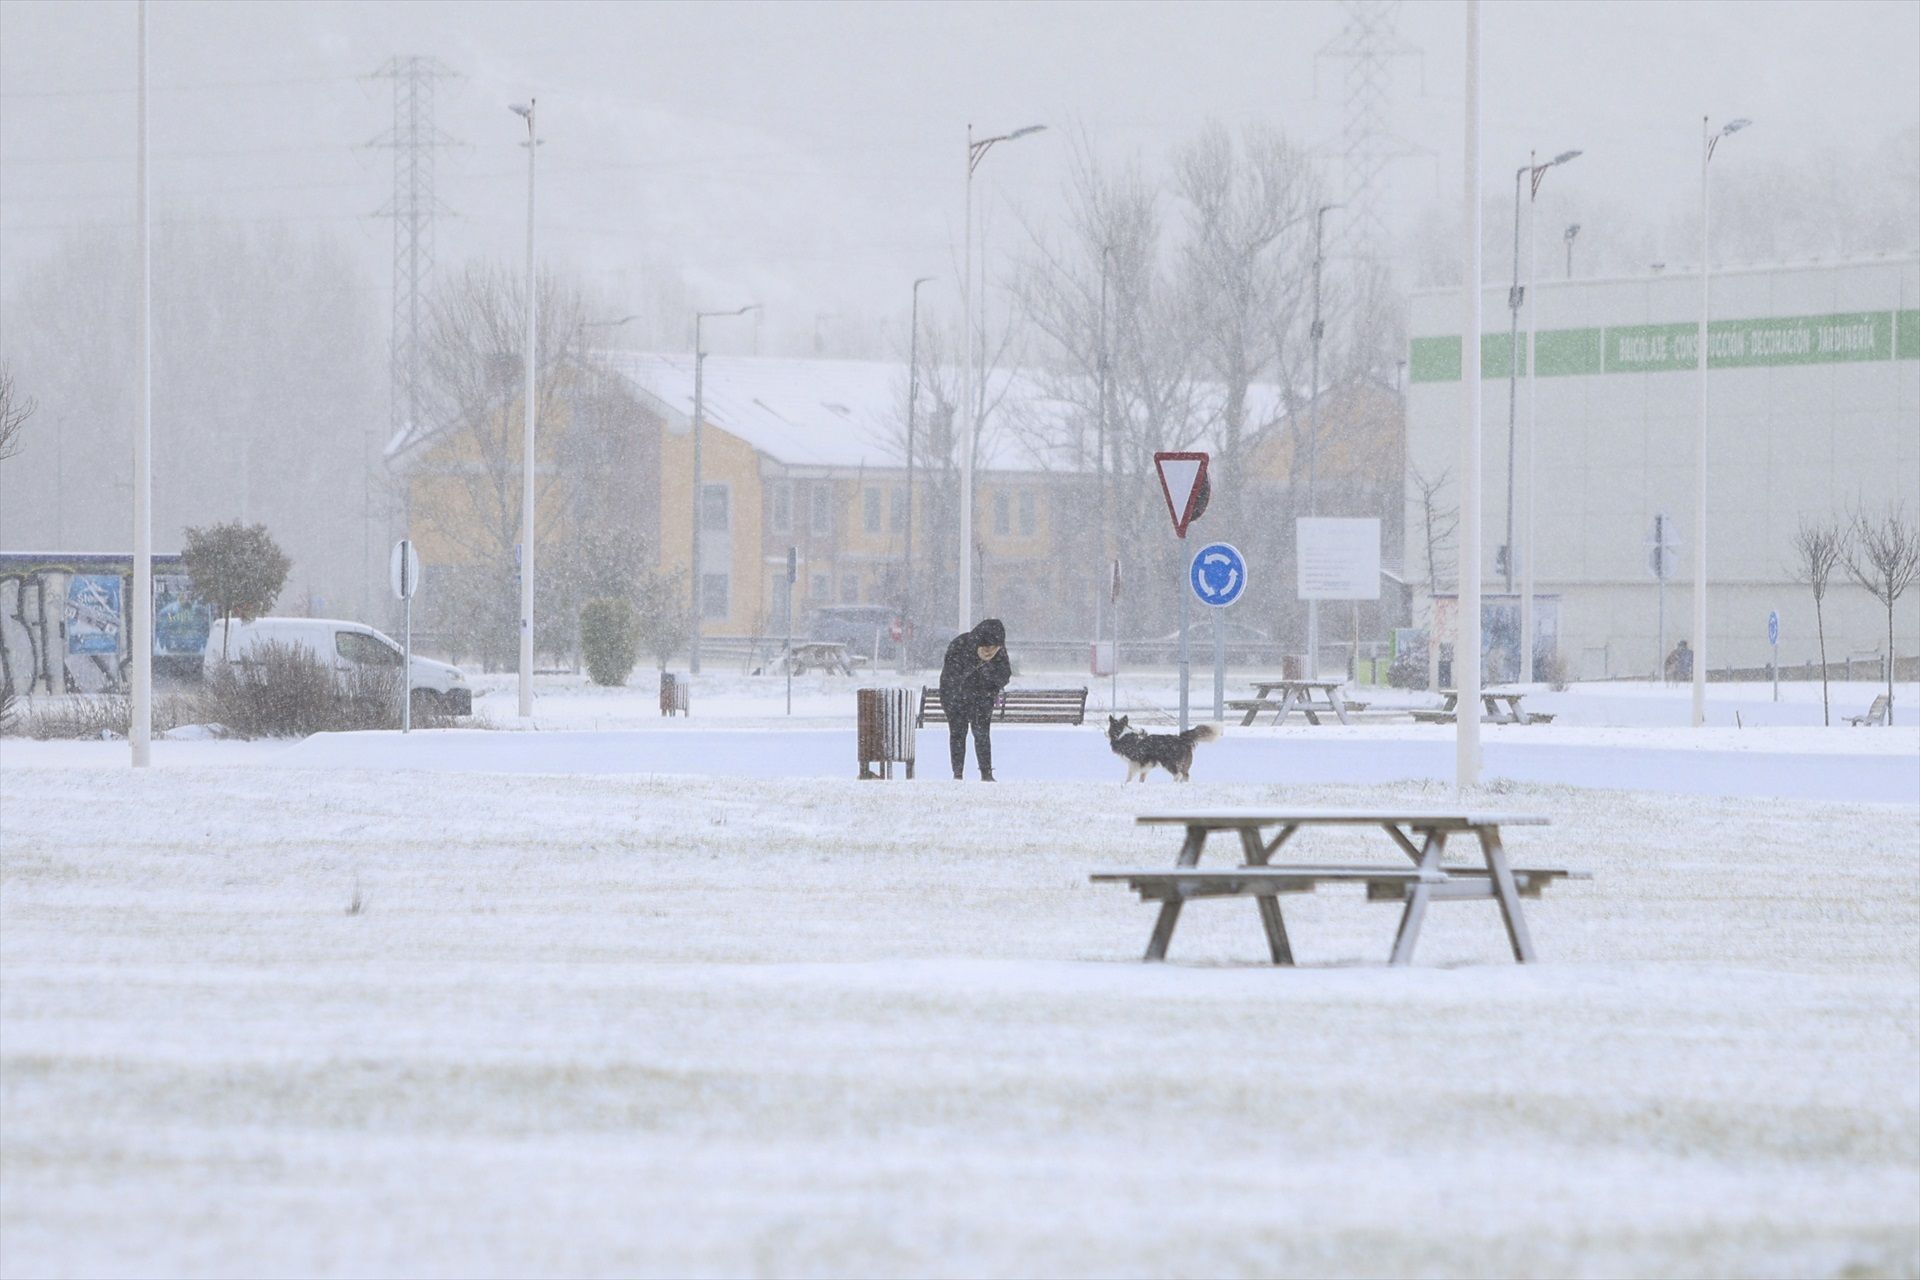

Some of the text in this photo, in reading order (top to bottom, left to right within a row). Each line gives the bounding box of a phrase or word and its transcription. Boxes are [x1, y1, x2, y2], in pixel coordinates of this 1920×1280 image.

[1674, 326, 1745, 360] CONSUCCIÓN
[1751, 320, 1810, 356] DECORACIÓN
[1818, 315, 1874, 352] JARDINERÍA
